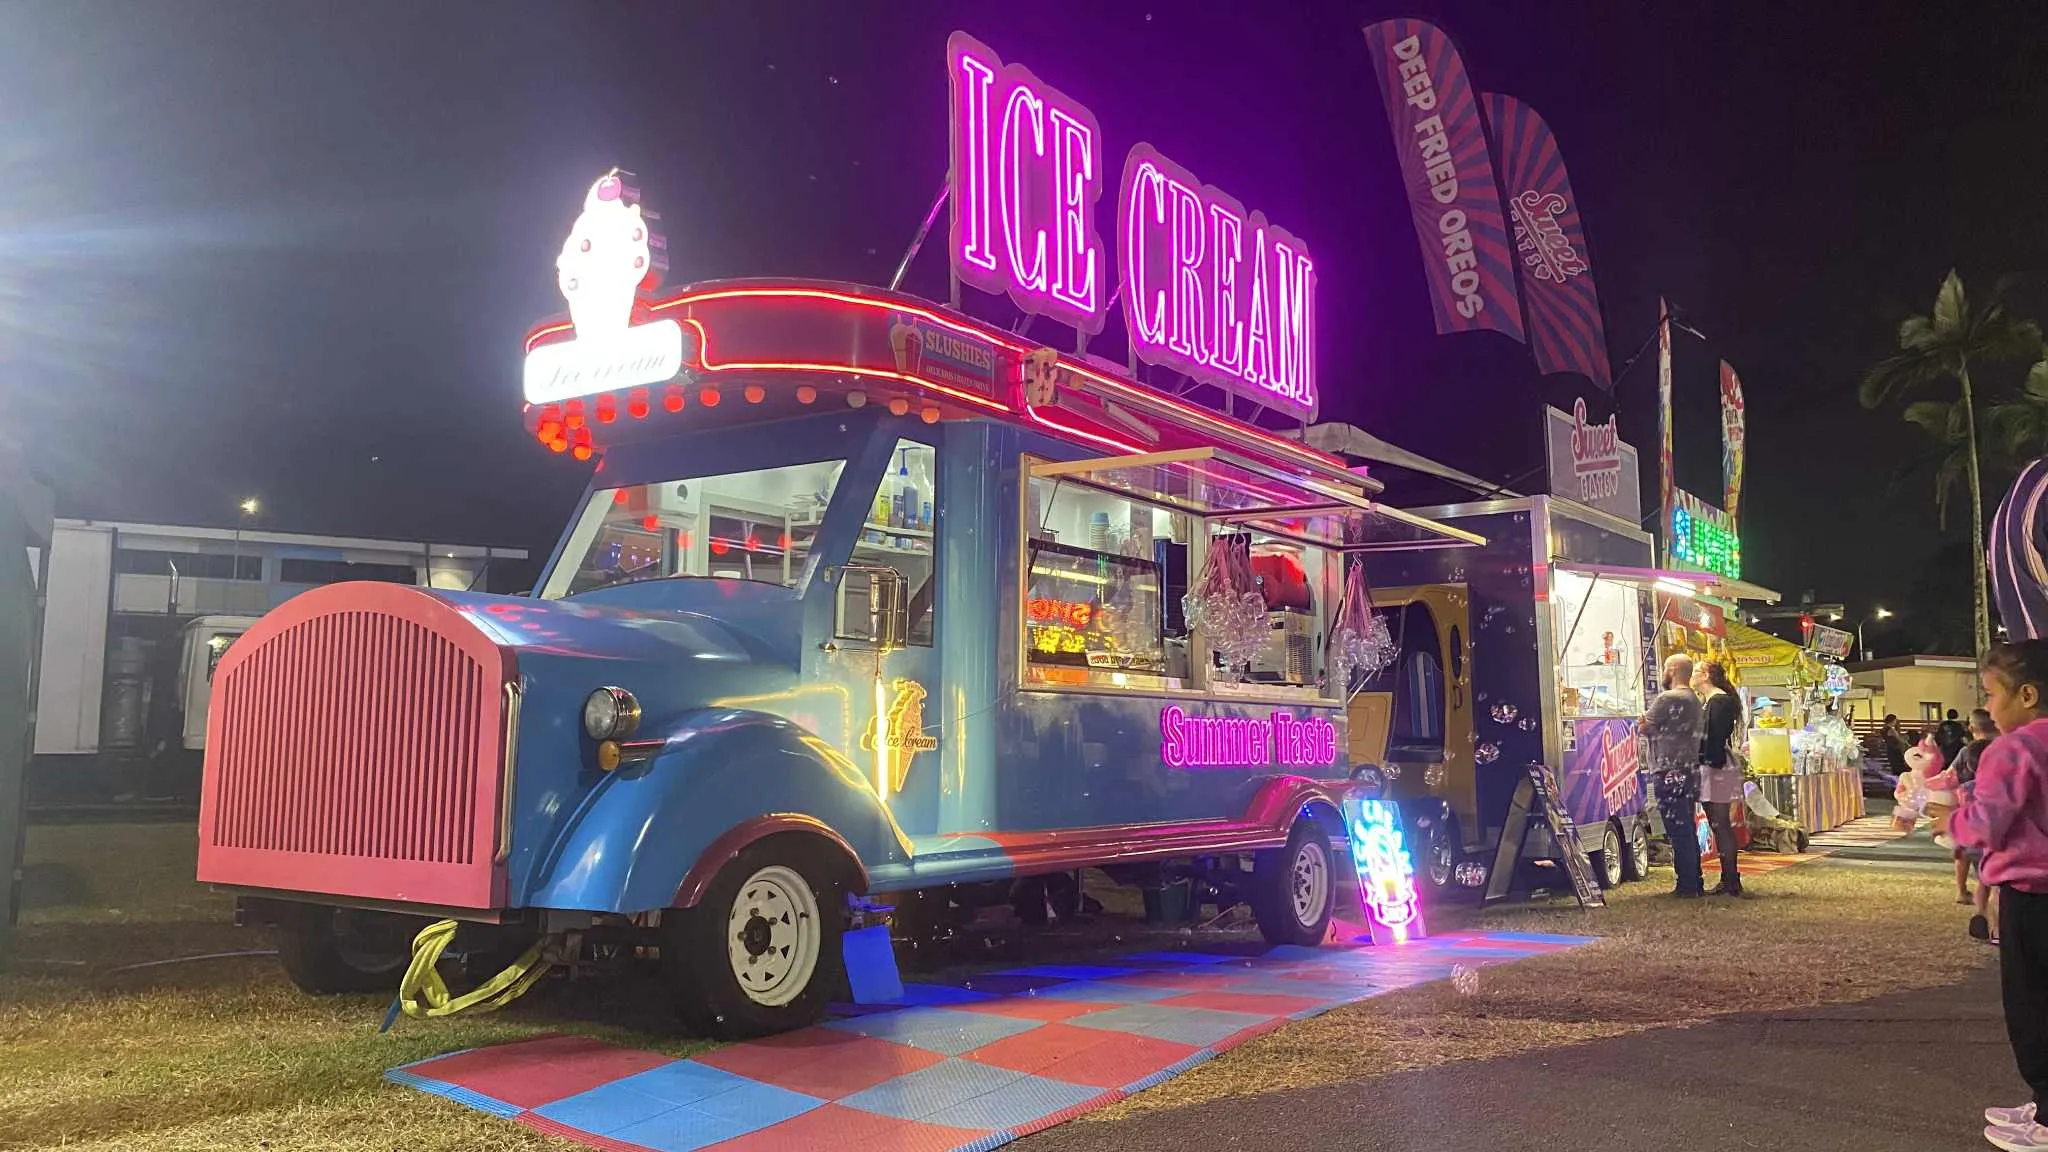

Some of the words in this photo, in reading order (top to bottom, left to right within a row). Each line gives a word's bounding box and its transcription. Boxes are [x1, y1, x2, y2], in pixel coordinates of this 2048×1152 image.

[1392, 35, 1436, 111] DEEP
[1415, 114, 1460, 204] FRIED
[1438, 209, 1484, 319] OREOS
[962, 55, 1096, 313] ICE
[1127, 162, 1313, 407] CREAM
[925, 330, 991, 370] SLUSHIES
[1571, 397, 1618, 462] Sweet
[1163, 705, 1271, 766] Summer
[1274, 712, 1336, 764] Taste
[1601, 721, 1638, 785] Sweet
